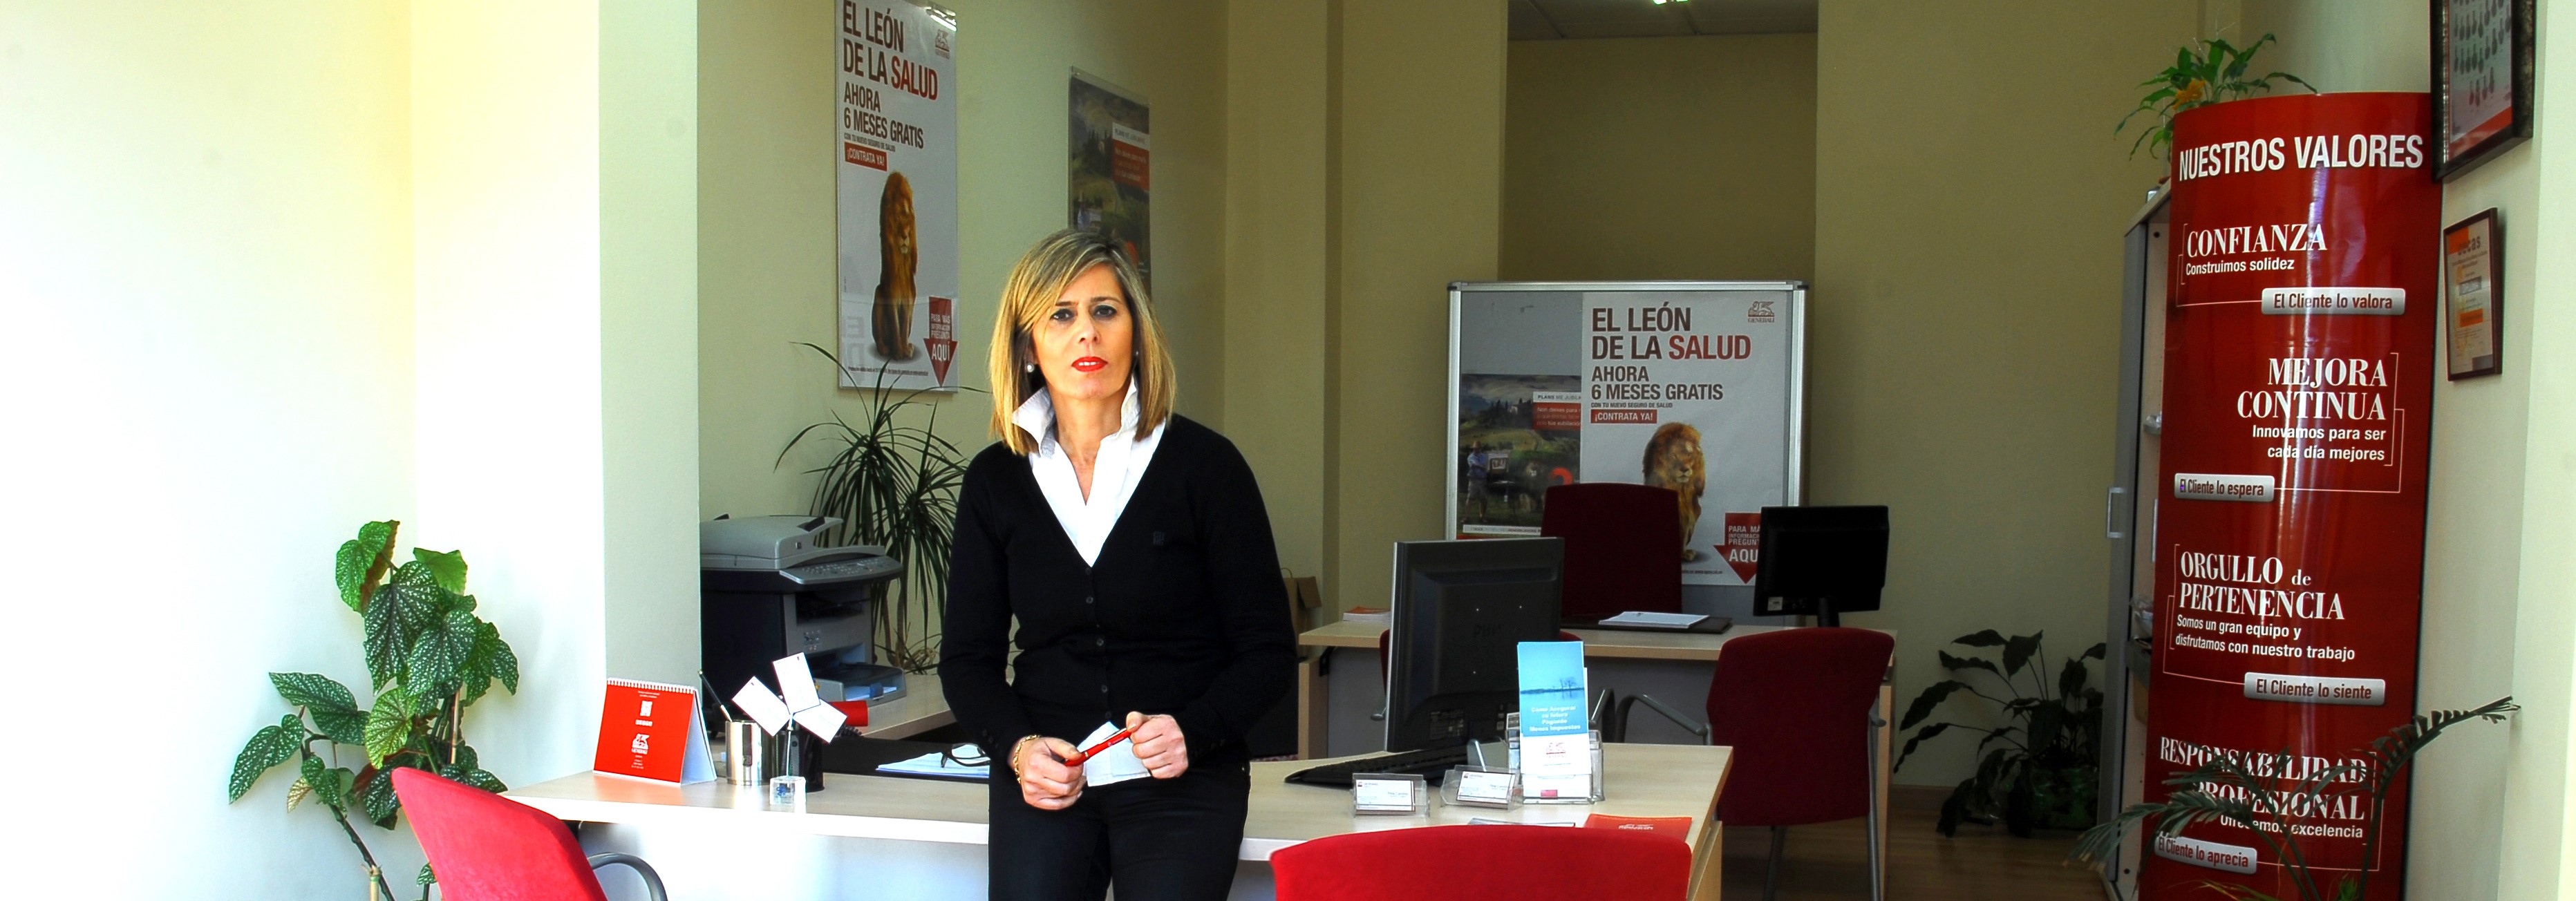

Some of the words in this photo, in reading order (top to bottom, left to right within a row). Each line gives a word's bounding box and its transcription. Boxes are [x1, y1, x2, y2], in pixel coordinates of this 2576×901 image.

[843, 0, 862, 37] EL
[865, 8, 904, 53] LEÓN
[843, 38, 864, 77] DE
[868, 47, 888, 85] LA
[891, 55, 938, 100] SALUD
[844, 82, 881, 113] AHORA
[844, 107, 851, 129] 6
[854, 109, 887, 139] MESES
[890, 120, 924, 149] GRATIS
[847, 147, 875, 164] ¡CONTRATA
[876, 154, 885, 166] YA!
[2179, 137, 2285, 182] NUESTROS
[2294, 134, 2423, 169] VALORES
[2187, 223, 2327, 258] CONFIANZA
[2186, 260, 2246, 276] Construimos
[2250, 257, 2295, 271] solidez
[2274, 294, 2284, 309] El
[2288, 293, 2332, 309] Cliente
[2337, 294, 2348, 308] lo
[2352, 294, 2393, 309] valora
[1592, 308, 1621, 332] EL
[1628, 301, 1691, 332] LEÓN
[932, 341, 950, 361] AQUÍ
[1592, 335, 1624, 360] DE
[1631, 335, 1662, 360] LA
[1668, 335, 1751, 360] SALUD
[1591, 366, 1649, 382] AHORA
[2268, 358, 2387, 388] MEJORA
[1591, 384, 1601, 400] 6
[1606, 383, 1661, 400] MESES
[1665, 383, 1723, 400] GRATIS
[1595, 412, 1638, 422] ¡CONTRATA
[1640, 412, 1653, 421] YA!
[2237, 390, 2386, 420] CONTINUA
[2253, 424, 2325, 439] Innovamos
[2329, 429, 2360, 442] para
[2364, 429, 2387, 440] ser
[2267, 445, 2300, 458] cada
[2304, 445, 2324, 459] día
[2329, 446, 2385, 462] mejores
[2180, 479, 2186, 493] El
[2188, 479, 2215, 494] Cliente
[2217, 480, 2225, 495] lo
[2228, 485, 2264, 498] espera
[1729, 549, 1758, 562] AQU
[2181, 551, 2283, 584] ORGULLO
[2291, 569, 2311, 586] de
[2179, 582, 2344, 620] PERTENENCIA
[2177, 614, 2203, 629] Somos
[2206, 620, 2216, 631] un
[2219, 622, 2242, 634] gran
[2246, 625, 2289, 639] equipo
[2293, 627, 2302, 640] y
[2176, 634, 2226, 651] disfrutamos
[2228, 642, 2248, 654] con
[2252, 644, 2302, 657] nuestro
[2306, 645, 2355, 662] trabajo
[2257, 679, 2267, 694] El
[2271, 680, 2314, 697] Cliente
[2318, 683, 2329, 698] lo
[2333, 683, 2371, 699] siente
[2291, 824, 2363, 838] excelencia
[2158, 837, 2165, 852] El
[2166, 838, 2193, 859] Cliente
[2196, 845, 2205, 860] lo
[2207, 852, 2248, 867] aprecia
